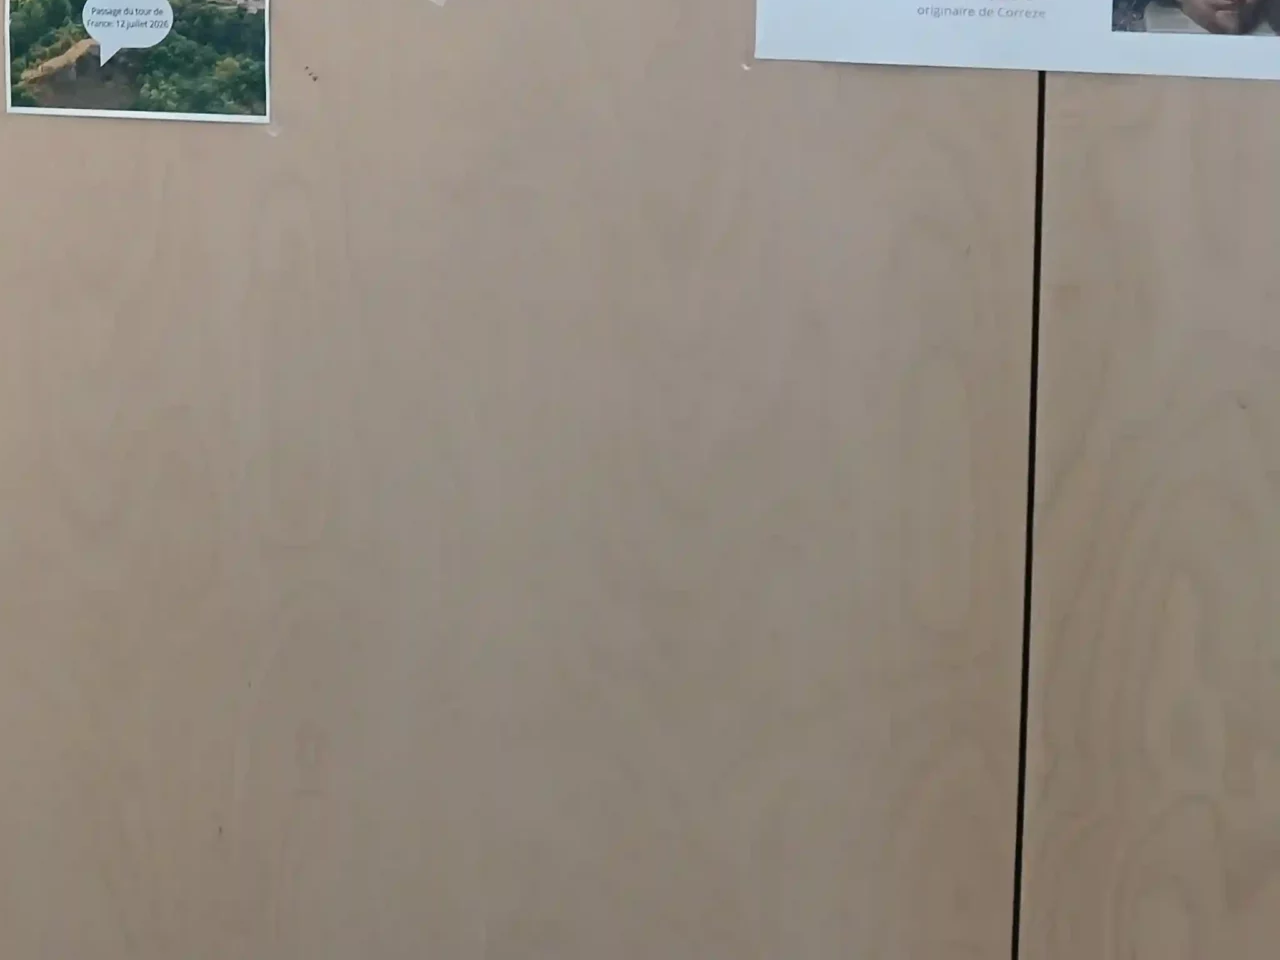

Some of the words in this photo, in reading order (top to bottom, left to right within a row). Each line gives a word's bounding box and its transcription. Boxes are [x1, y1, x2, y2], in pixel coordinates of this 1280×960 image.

[91, 7, 122, 17] Passage
[123, 7, 134, 16] du
[135, 8, 152, 16] tour
[153, 7, 164, 16] de
[916, 6, 976, 18] originaire
[978, 6, 994, 17] de
[116, 20, 125, 28] 12
[126, 19, 148, 31] juillet
[149, 20, 169, 29] 2026
